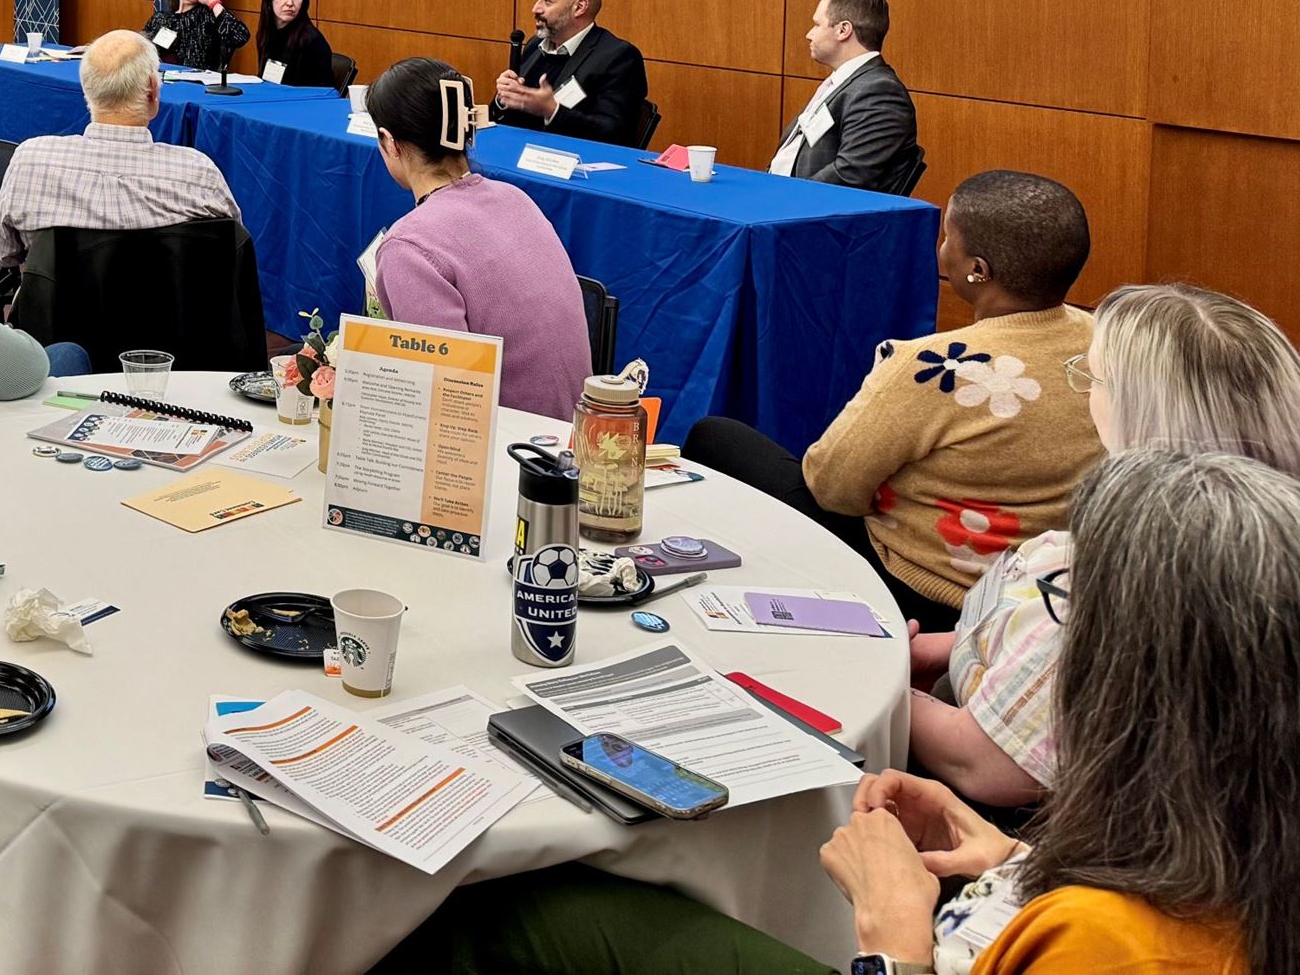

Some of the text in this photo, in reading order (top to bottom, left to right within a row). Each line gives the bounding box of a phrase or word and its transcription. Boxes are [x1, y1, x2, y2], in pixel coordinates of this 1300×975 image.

[390, 334, 449, 356] Table 6
[379, 366, 399, 374] Agenda
[527, 605, 577, 619] UNITED
